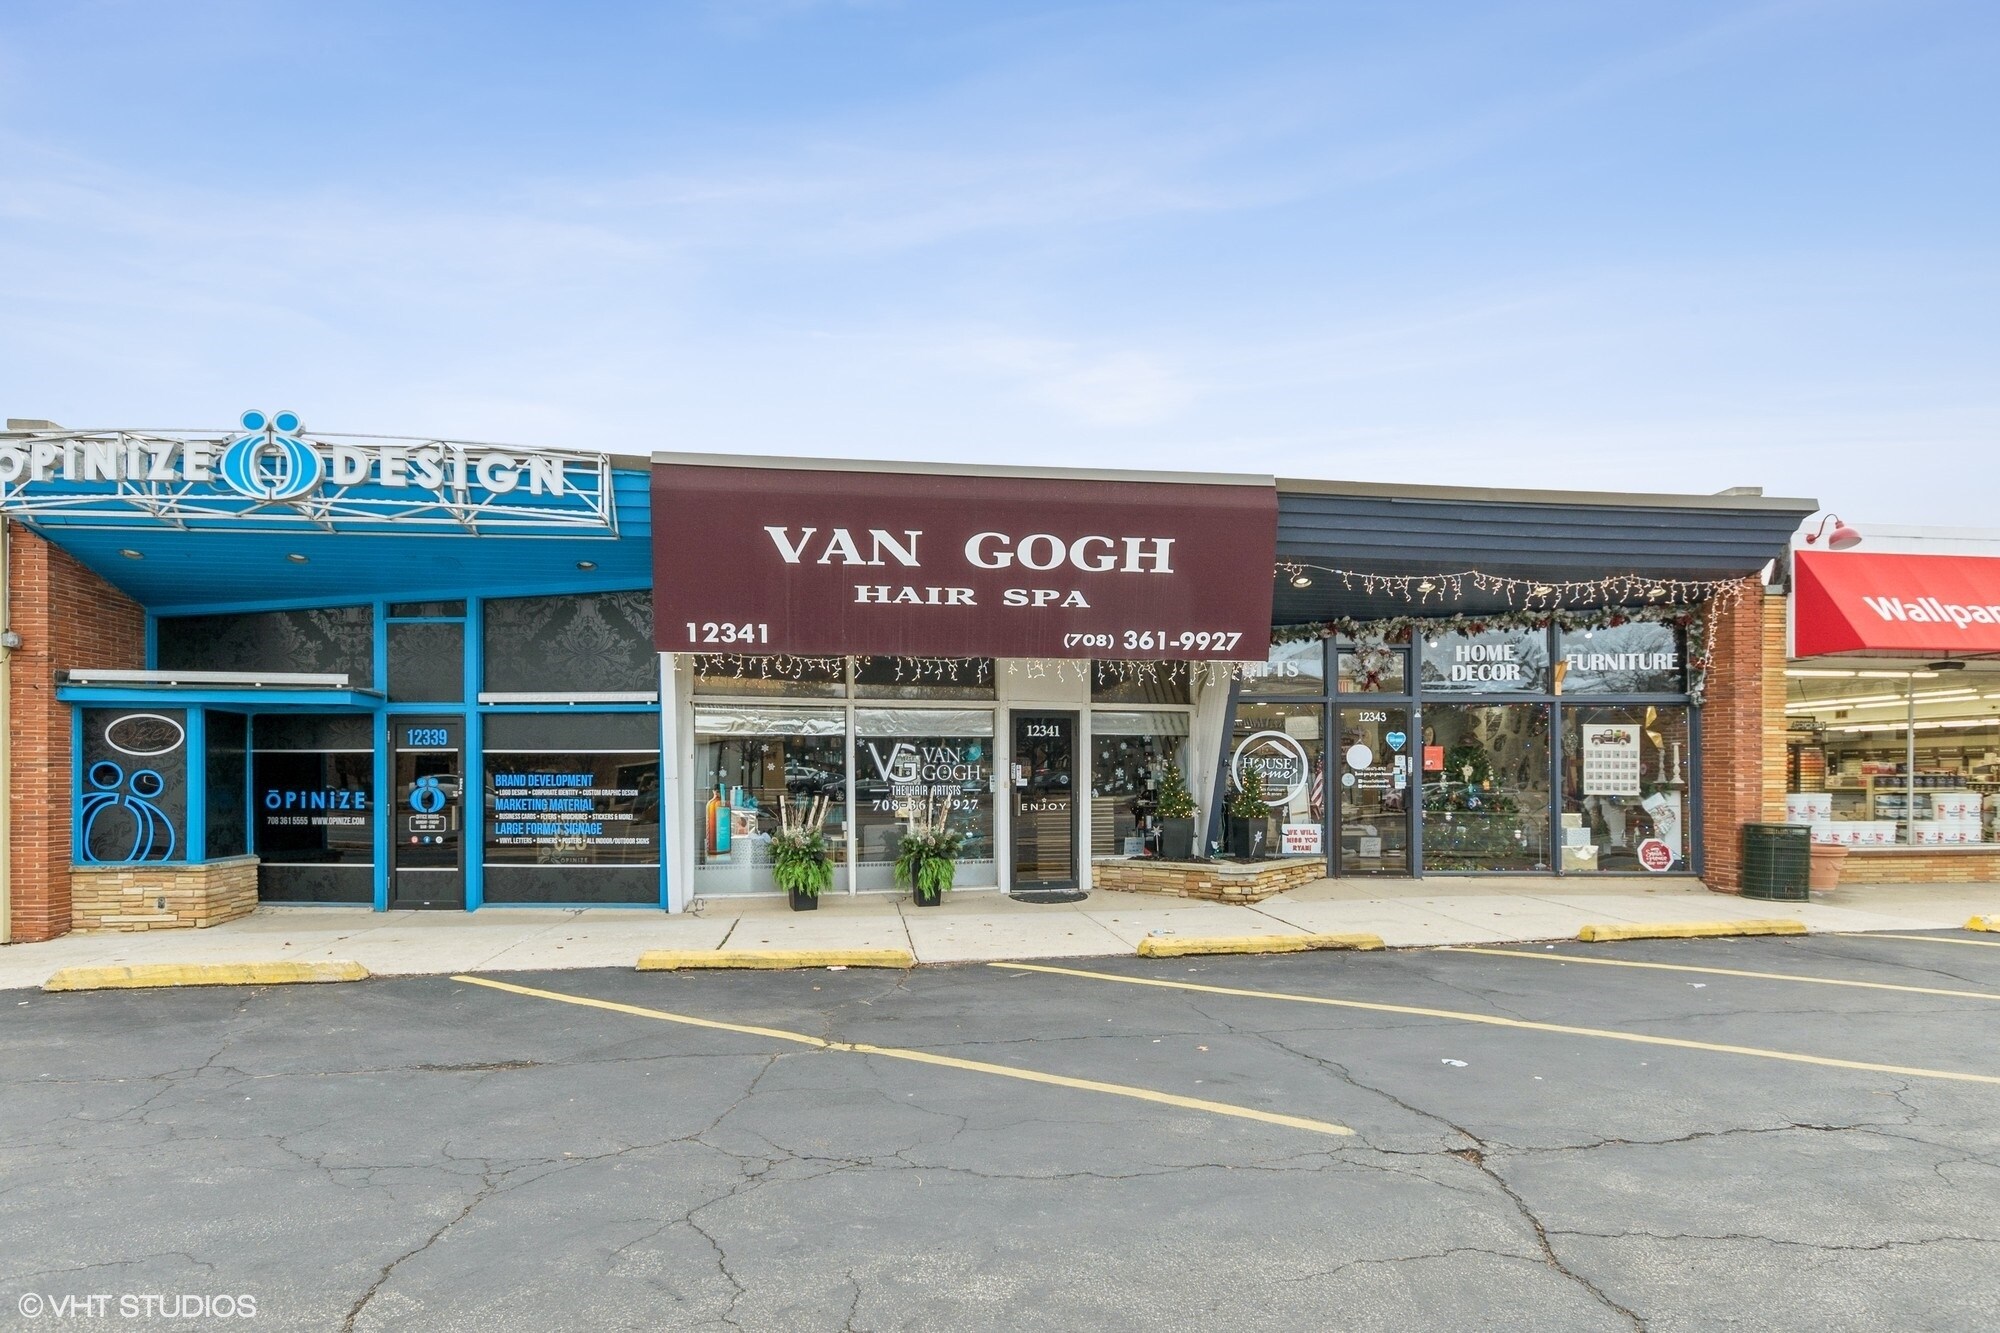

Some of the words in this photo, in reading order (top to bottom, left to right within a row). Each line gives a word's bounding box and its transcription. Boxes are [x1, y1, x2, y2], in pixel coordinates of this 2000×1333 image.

[763, 525, 924, 567] VAN
[963, 531, 1176, 574] GOGH
[853, 584, 978, 606] HAIR
[1002, 588, 1091, 608] SPA
[686, 622, 768, 644] 12341
[1063, 633, 1114, 649] (708)
[1123, 630, 1243, 651] 361-9927
[1455, 644, 1516, 662] HOME
[1566, 653, 1680, 671] FURNITURE
[1451, 664, 1520, 681] DECOR
[1359, 711, 1387, 722] 12343
[407, 728, 448, 746] 12339
[1027, 725, 1060, 737] 12341
[921, 747, 961, 763] VAN
[1242, 757, 1293, 770] HOUSE
[495, 774, 526, 787] BRAND
[528, 774, 594, 787] DEVELOPMENT
[921, 764, 981, 781] GOGH
[892, 785, 906, 796] THE
[909, 785, 928, 796] HAIR
[932, 785, 961, 796] ARTISTS
[495, 798, 548, 811] MARKETING
[550, 799, 594, 811] MATERIAL
[1021, 802, 1067, 811] ENJOY
[267, 816, 279, 825] 708
[279, 816, 292, 825] 361
[292, 816, 309, 825] 5555
[311, 816, 366, 826] WWW.OPINIZE.COM
[495, 822, 524, 835] LARGE
[525, 822, 562, 835] FORMAT
[563, 822, 603, 835] SIGNAGE
